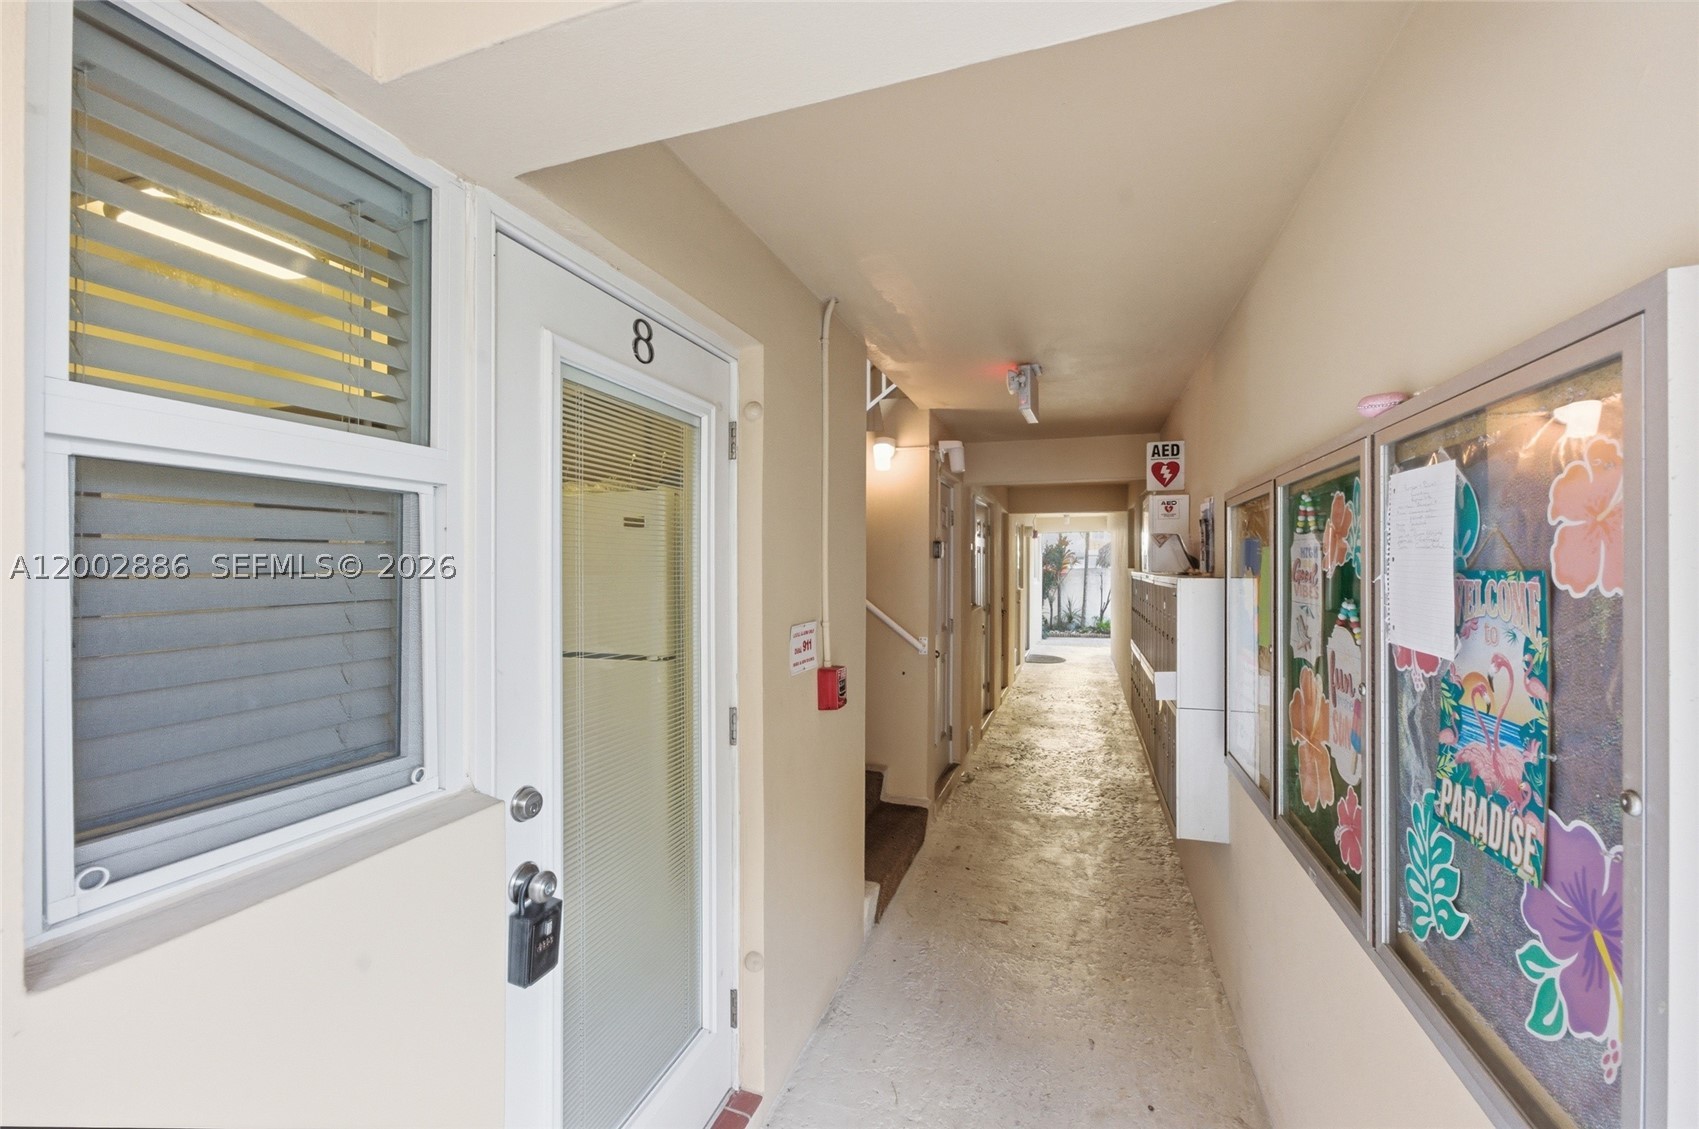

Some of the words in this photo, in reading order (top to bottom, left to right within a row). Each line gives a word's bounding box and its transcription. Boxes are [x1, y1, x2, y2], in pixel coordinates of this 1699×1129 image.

[632, 318, 655, 364] 8
[1151, 443, 1180, 458] AED
[802, 639, 812, 652] 911
[1484, 622, 1498, 647] to
[1439, 776, 1537, 877] PARADISE
